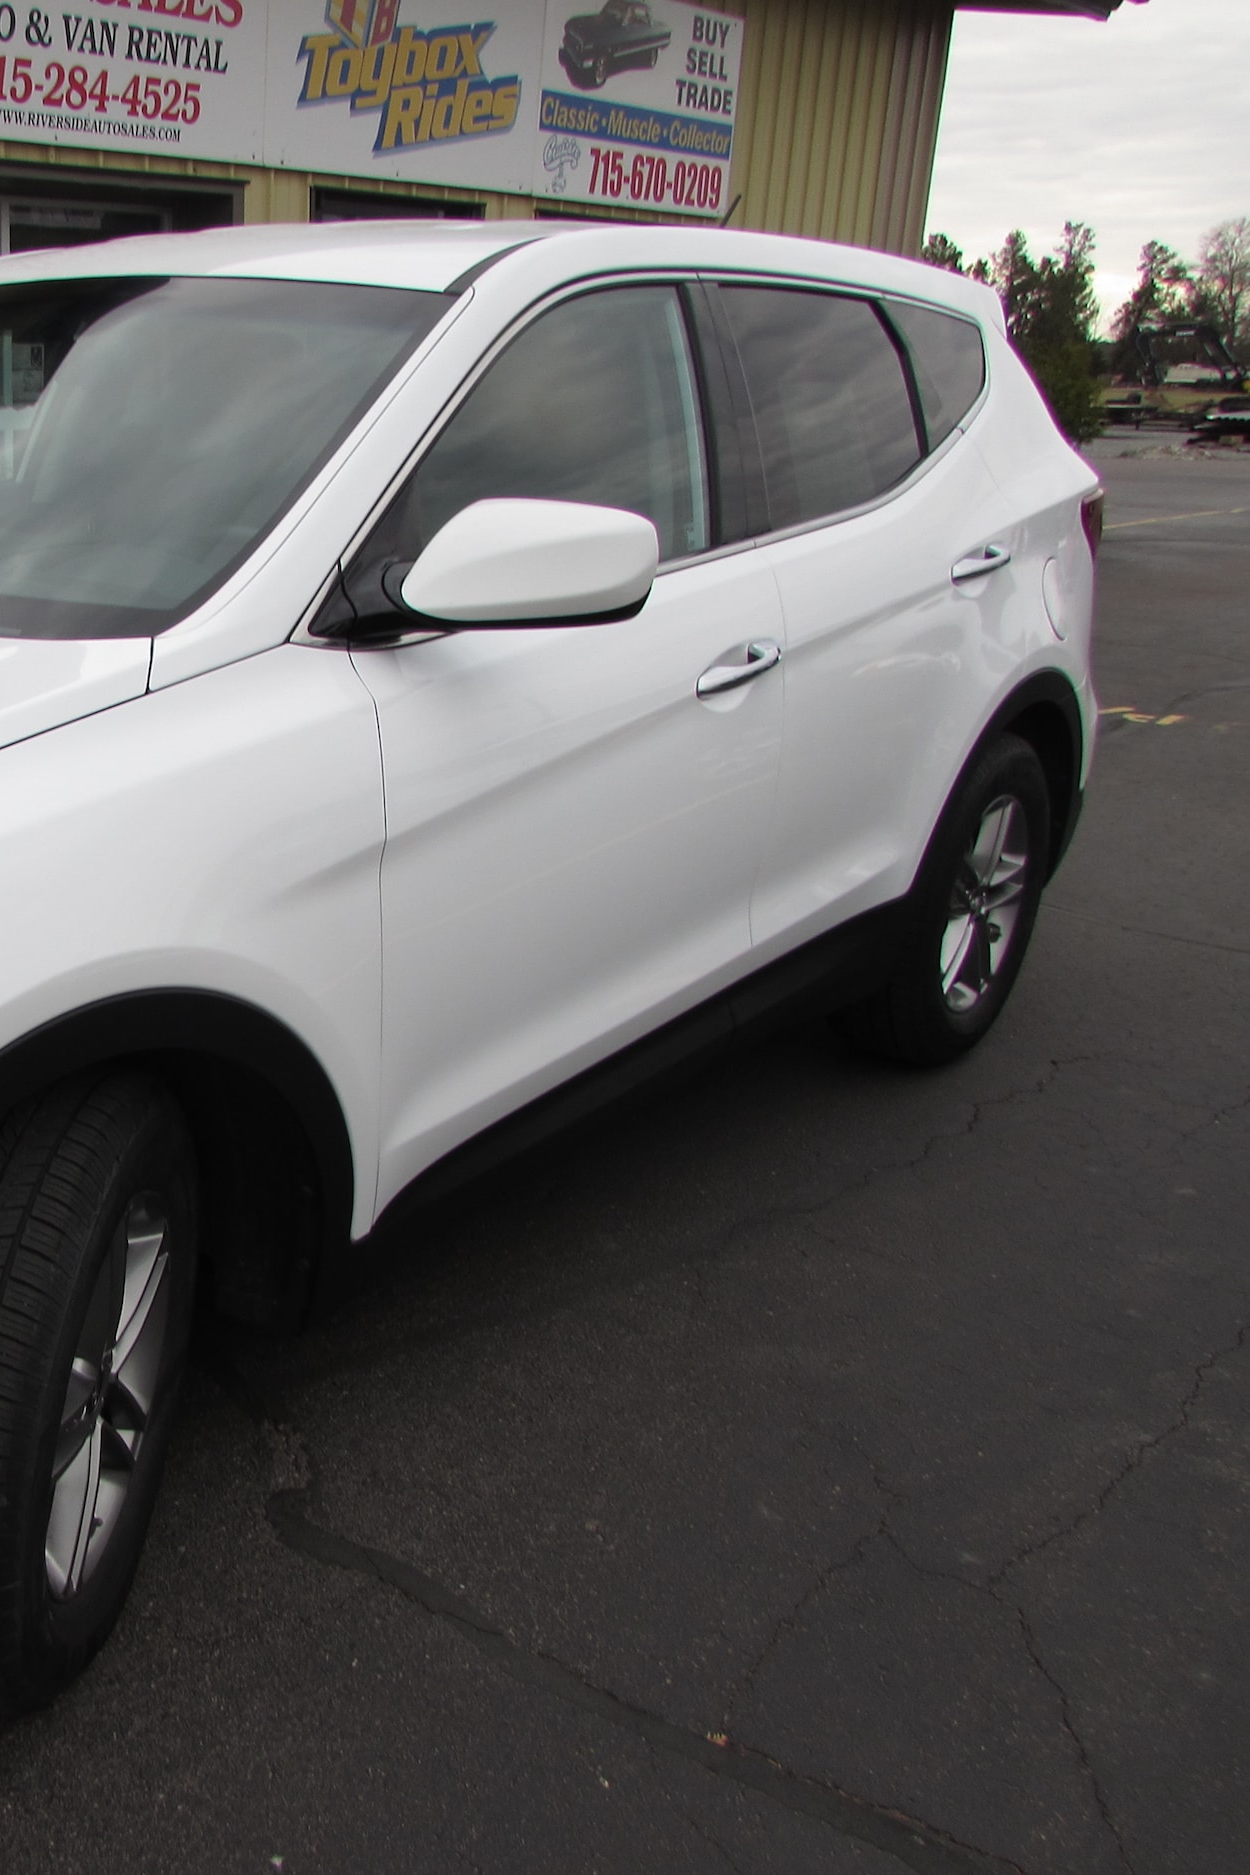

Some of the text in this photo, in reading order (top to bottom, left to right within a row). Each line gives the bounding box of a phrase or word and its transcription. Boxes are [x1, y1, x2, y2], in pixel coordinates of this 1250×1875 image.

[25, 8, 52, 48] &
[62, 14, 119, 58] VAN
[125, 25, 229, 74] RENTAL
[692, 15, 730, 48] BUY
[297, 24, 497, 109] Toybox
[686, 47, 728, 82] SELL
[375, 77, 520, 153] Rides
[541, 97, 733, 155] Classic Muscle Collector
[675, 79, 733, 115] TRADE
[588, 147, 722, 210] 715-670-0209
